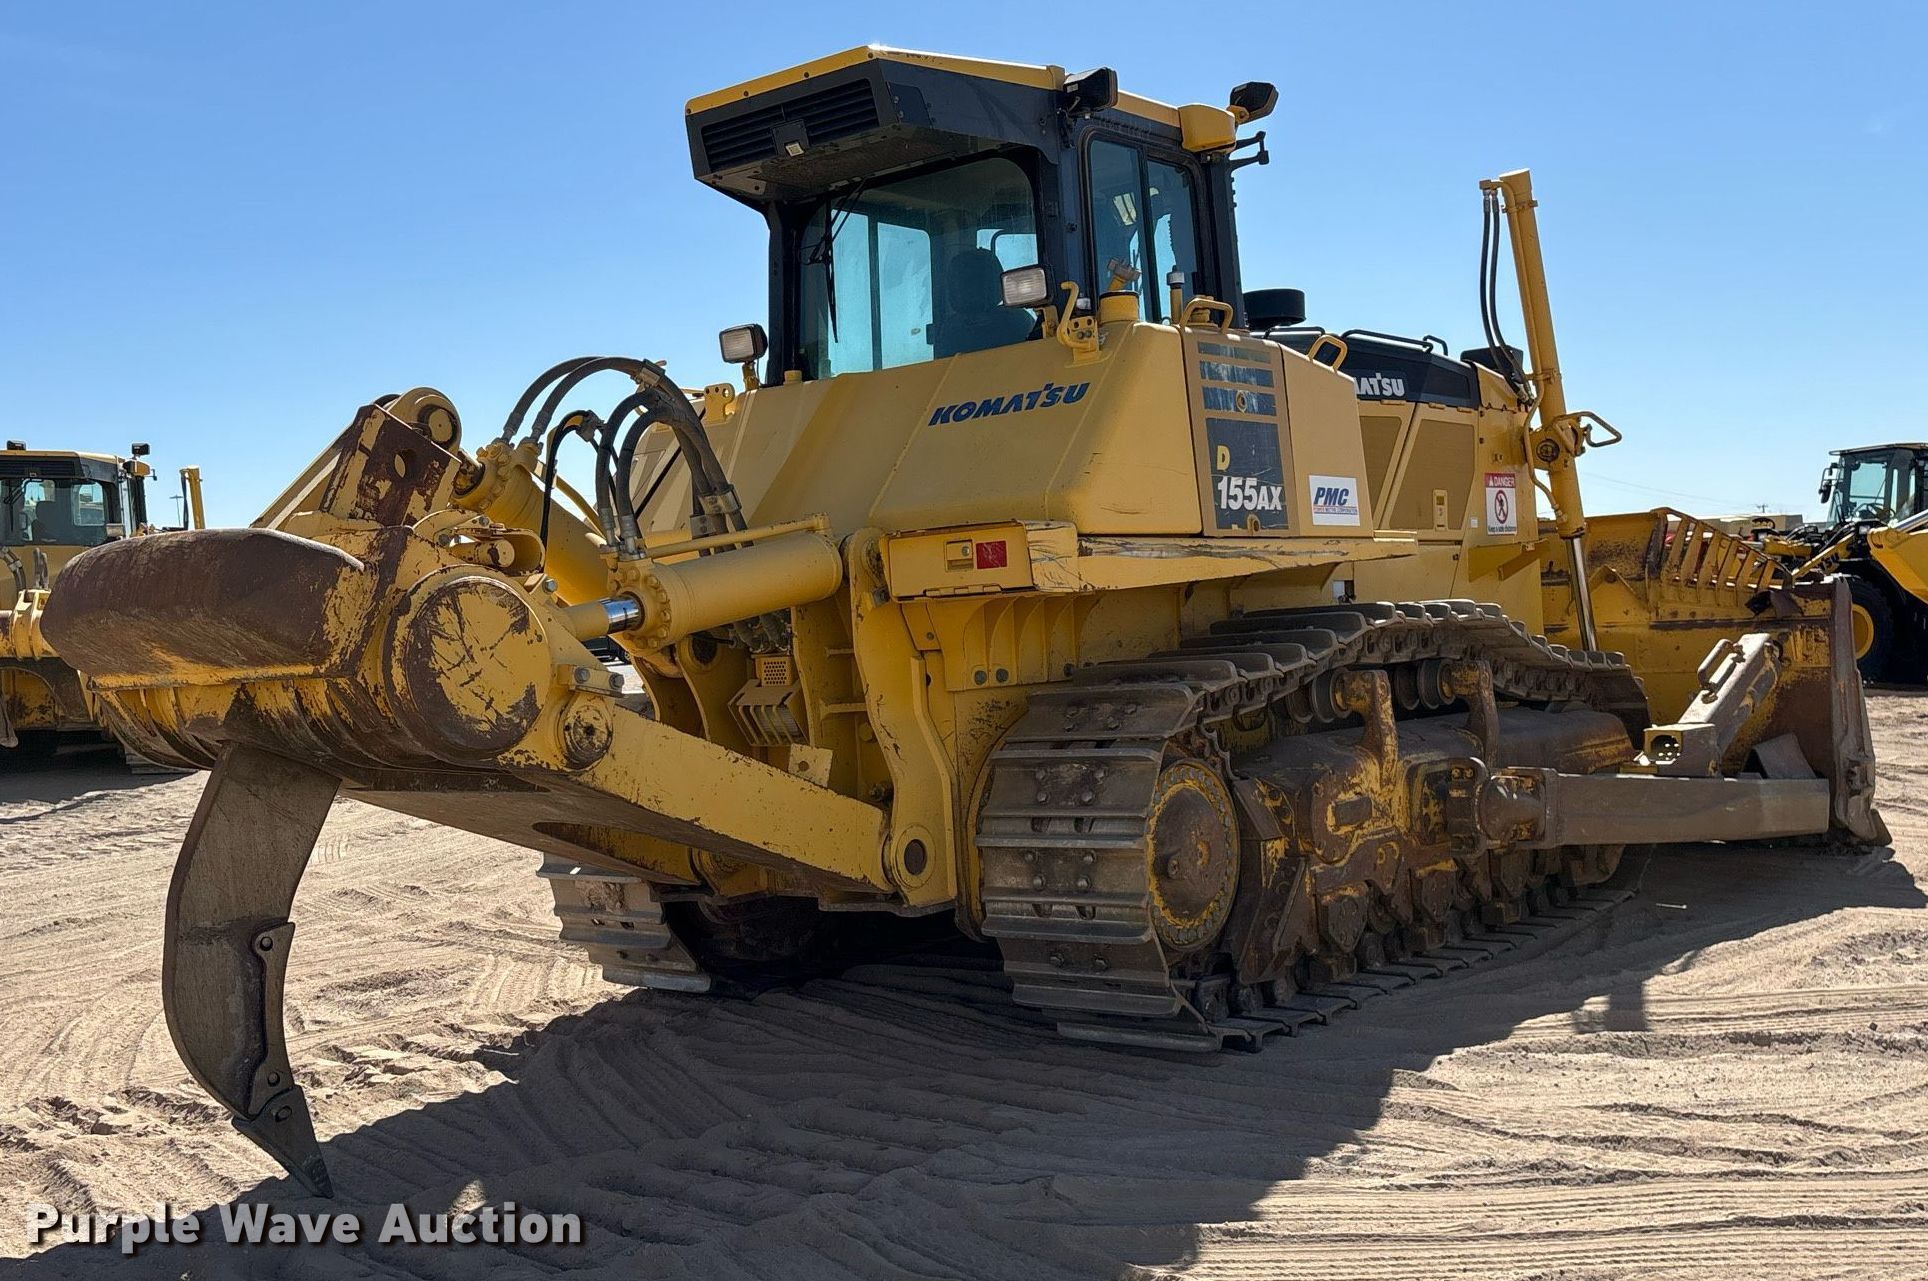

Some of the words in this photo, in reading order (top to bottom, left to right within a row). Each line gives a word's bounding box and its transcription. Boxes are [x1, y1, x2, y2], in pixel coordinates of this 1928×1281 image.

[928, 382, 1091, 427] KOMATSU
[1216, 445, 1231, 471] D
[1493, 476, 1515, 487] DANGER
[1313, 486, 1350, 506] PMC
